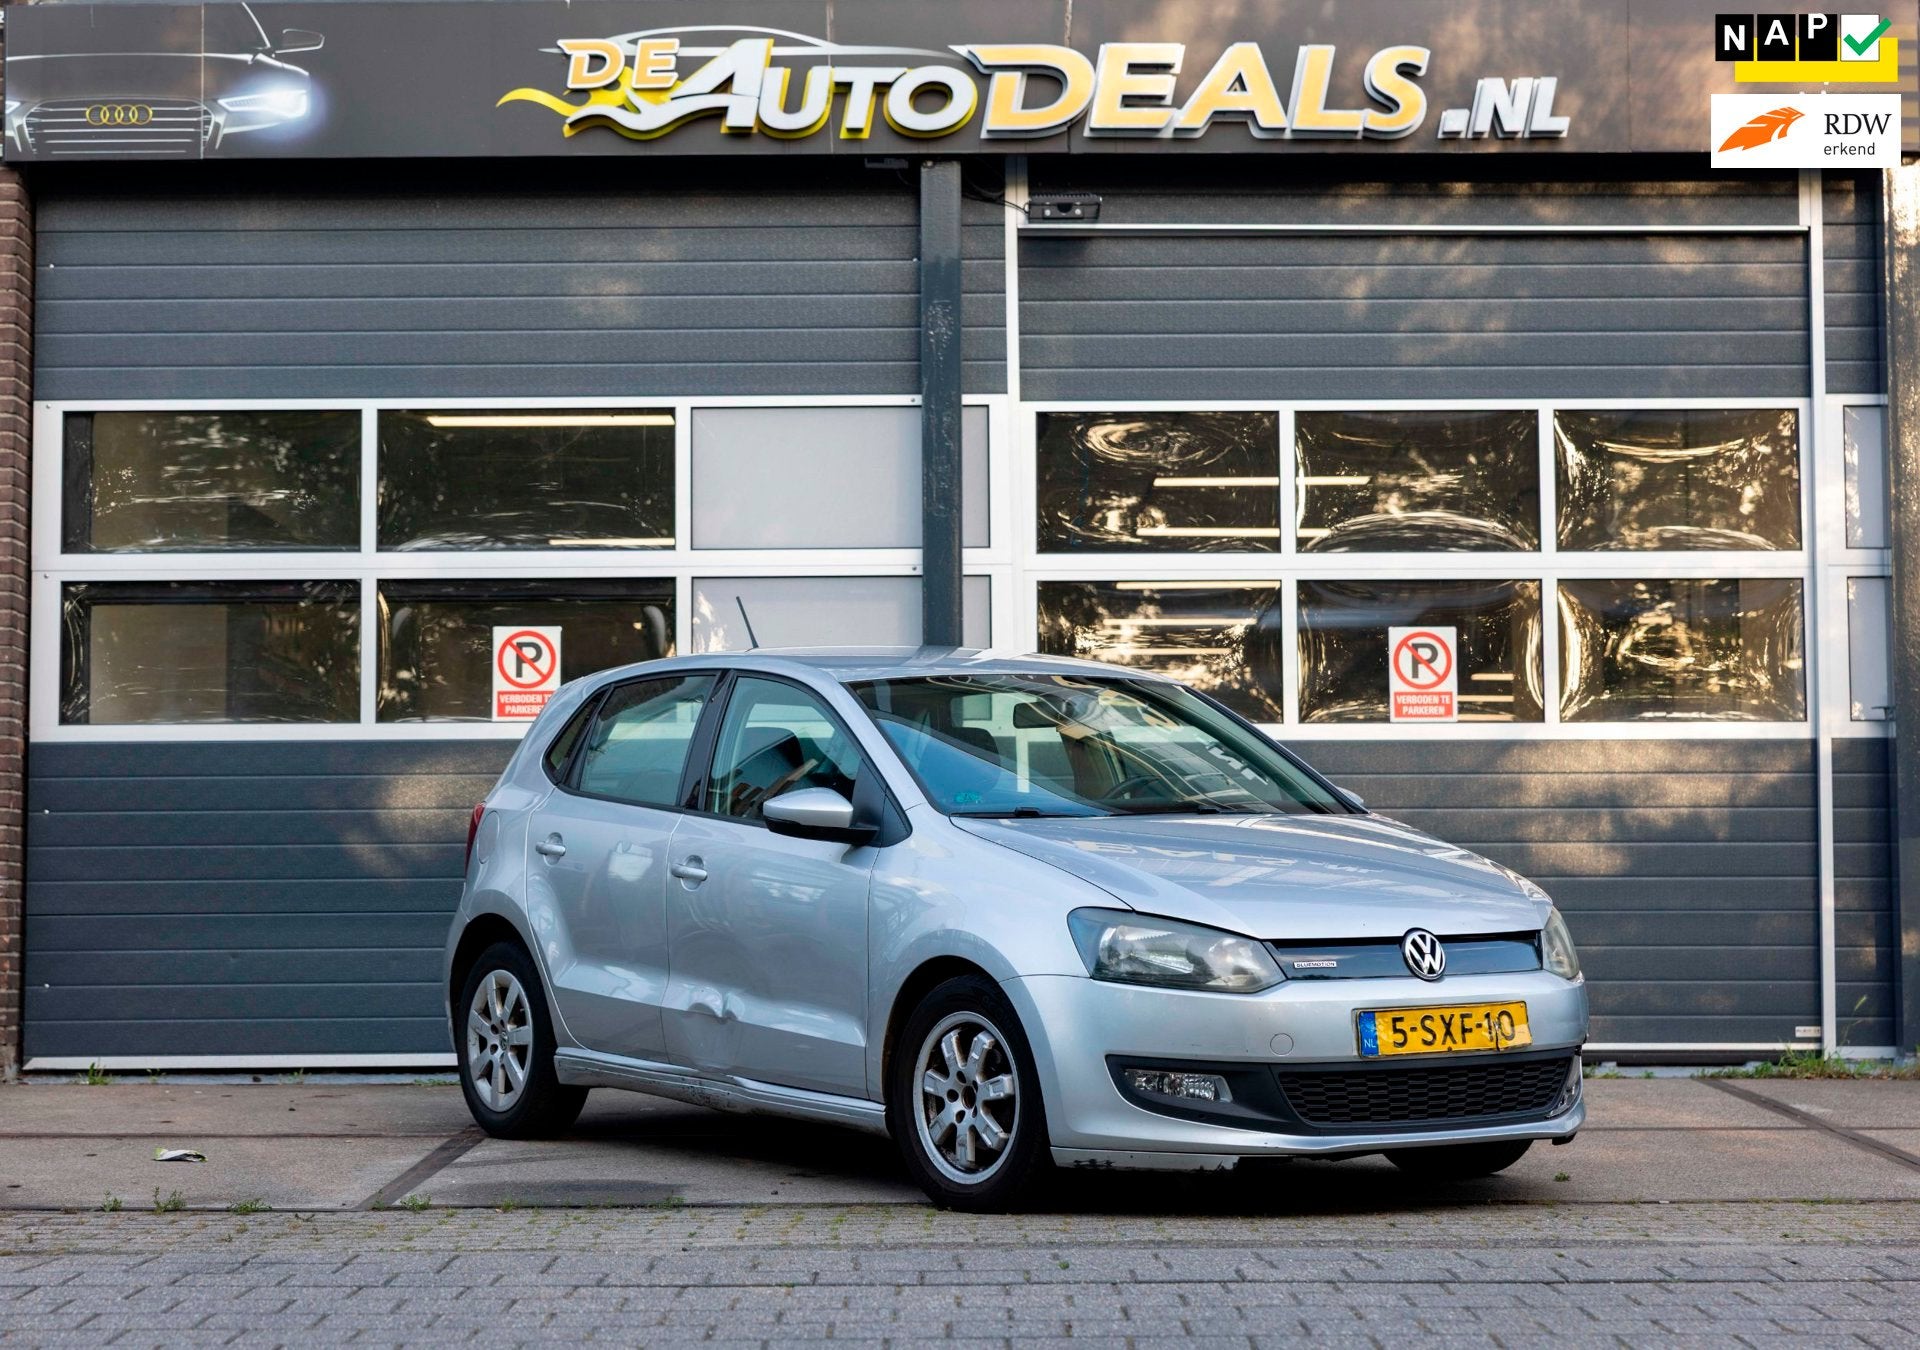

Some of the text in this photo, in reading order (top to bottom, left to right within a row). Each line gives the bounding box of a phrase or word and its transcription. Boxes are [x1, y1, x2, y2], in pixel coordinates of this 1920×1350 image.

[499, 693, 543, 704] VERBODEN
[1396, 694, 1452, 705] VERBODEN TE
[1402, 705, 1446, 715] PARKEREN
[1392, 1010, 1517, 1049] 5-SXF-10
[1364, 1038, 1377, 1049] NL
